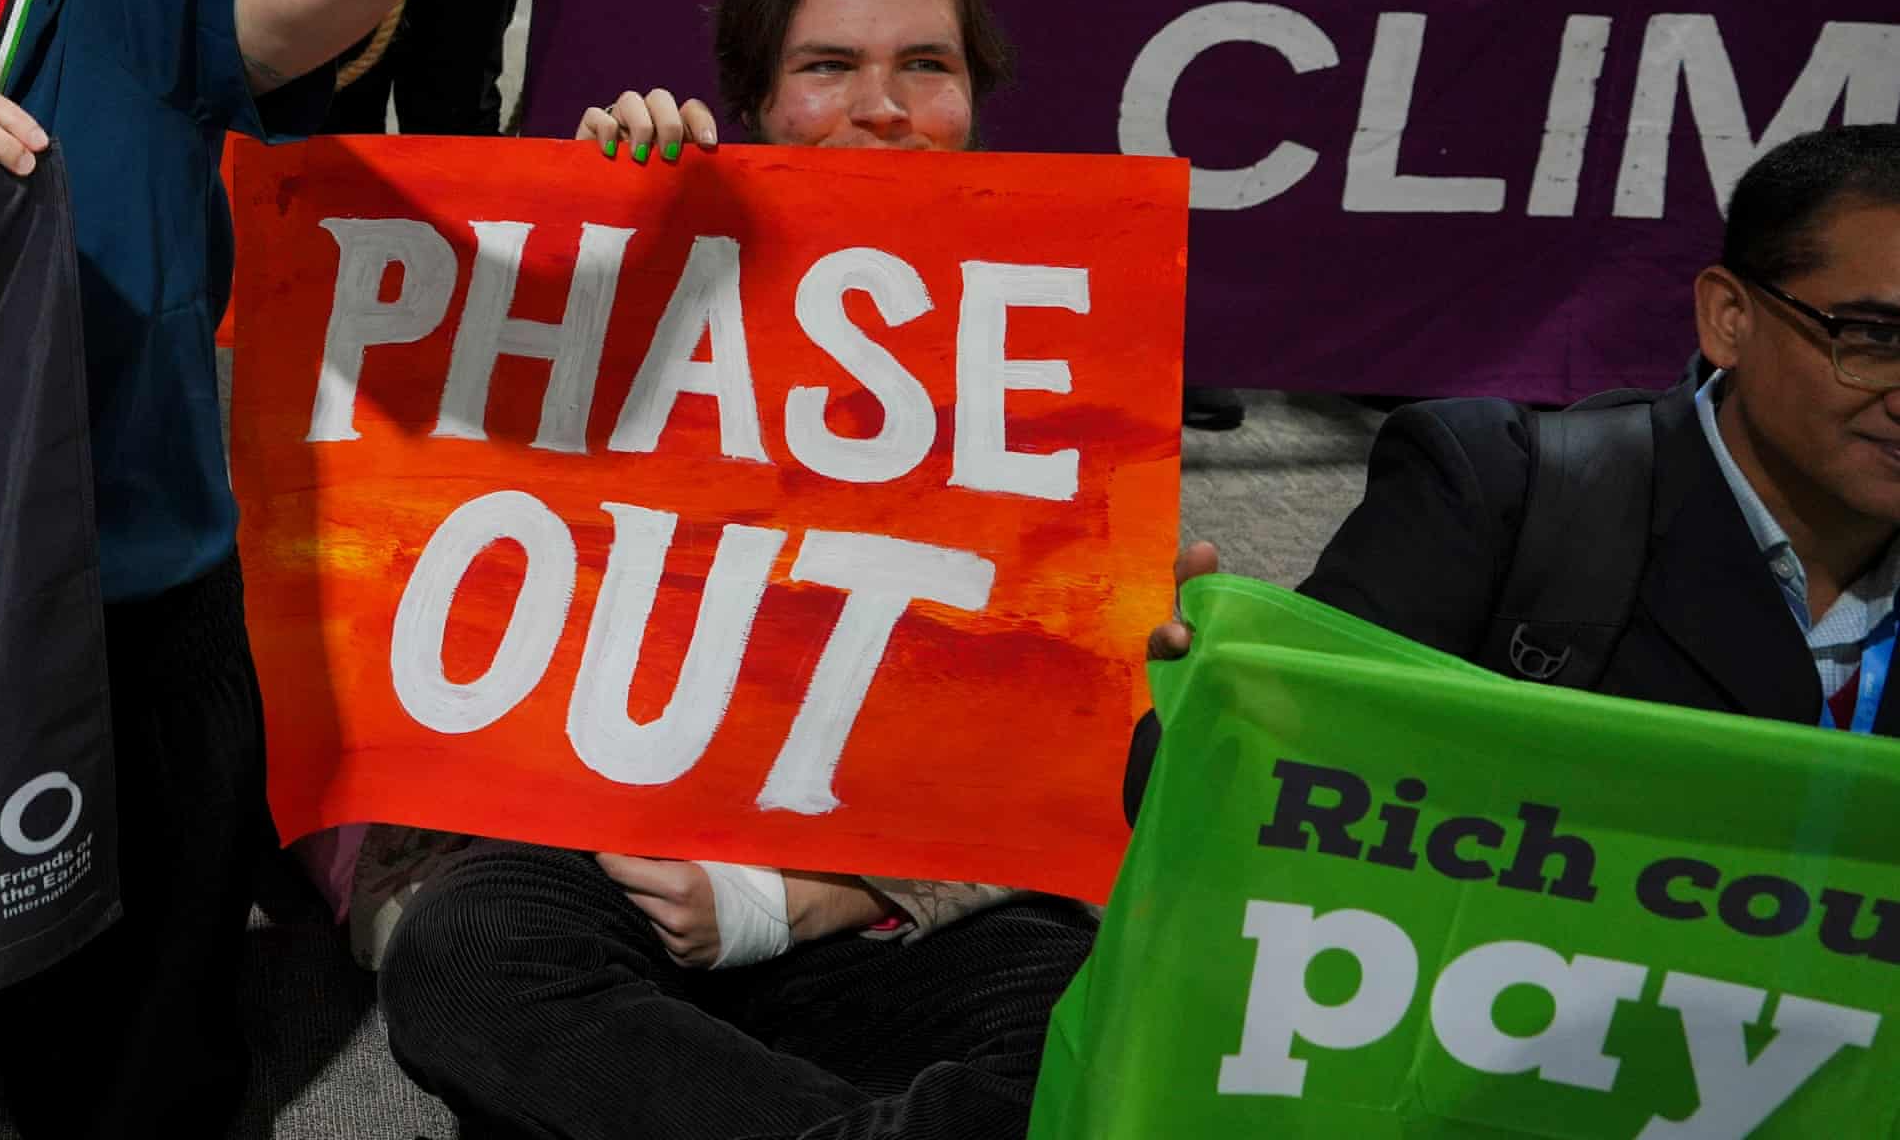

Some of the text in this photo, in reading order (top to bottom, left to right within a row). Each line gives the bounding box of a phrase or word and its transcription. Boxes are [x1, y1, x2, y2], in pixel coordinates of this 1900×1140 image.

[304, 216, 1090, 501] PHASE
[389, 489, 997, 816] OUT
[0, 849, 75, 890] Friends
[0, 849, 92, 906] the Earth
[1257, 757, 1598, 904] Rich
[1217, 899, 1882, 1140] pay
